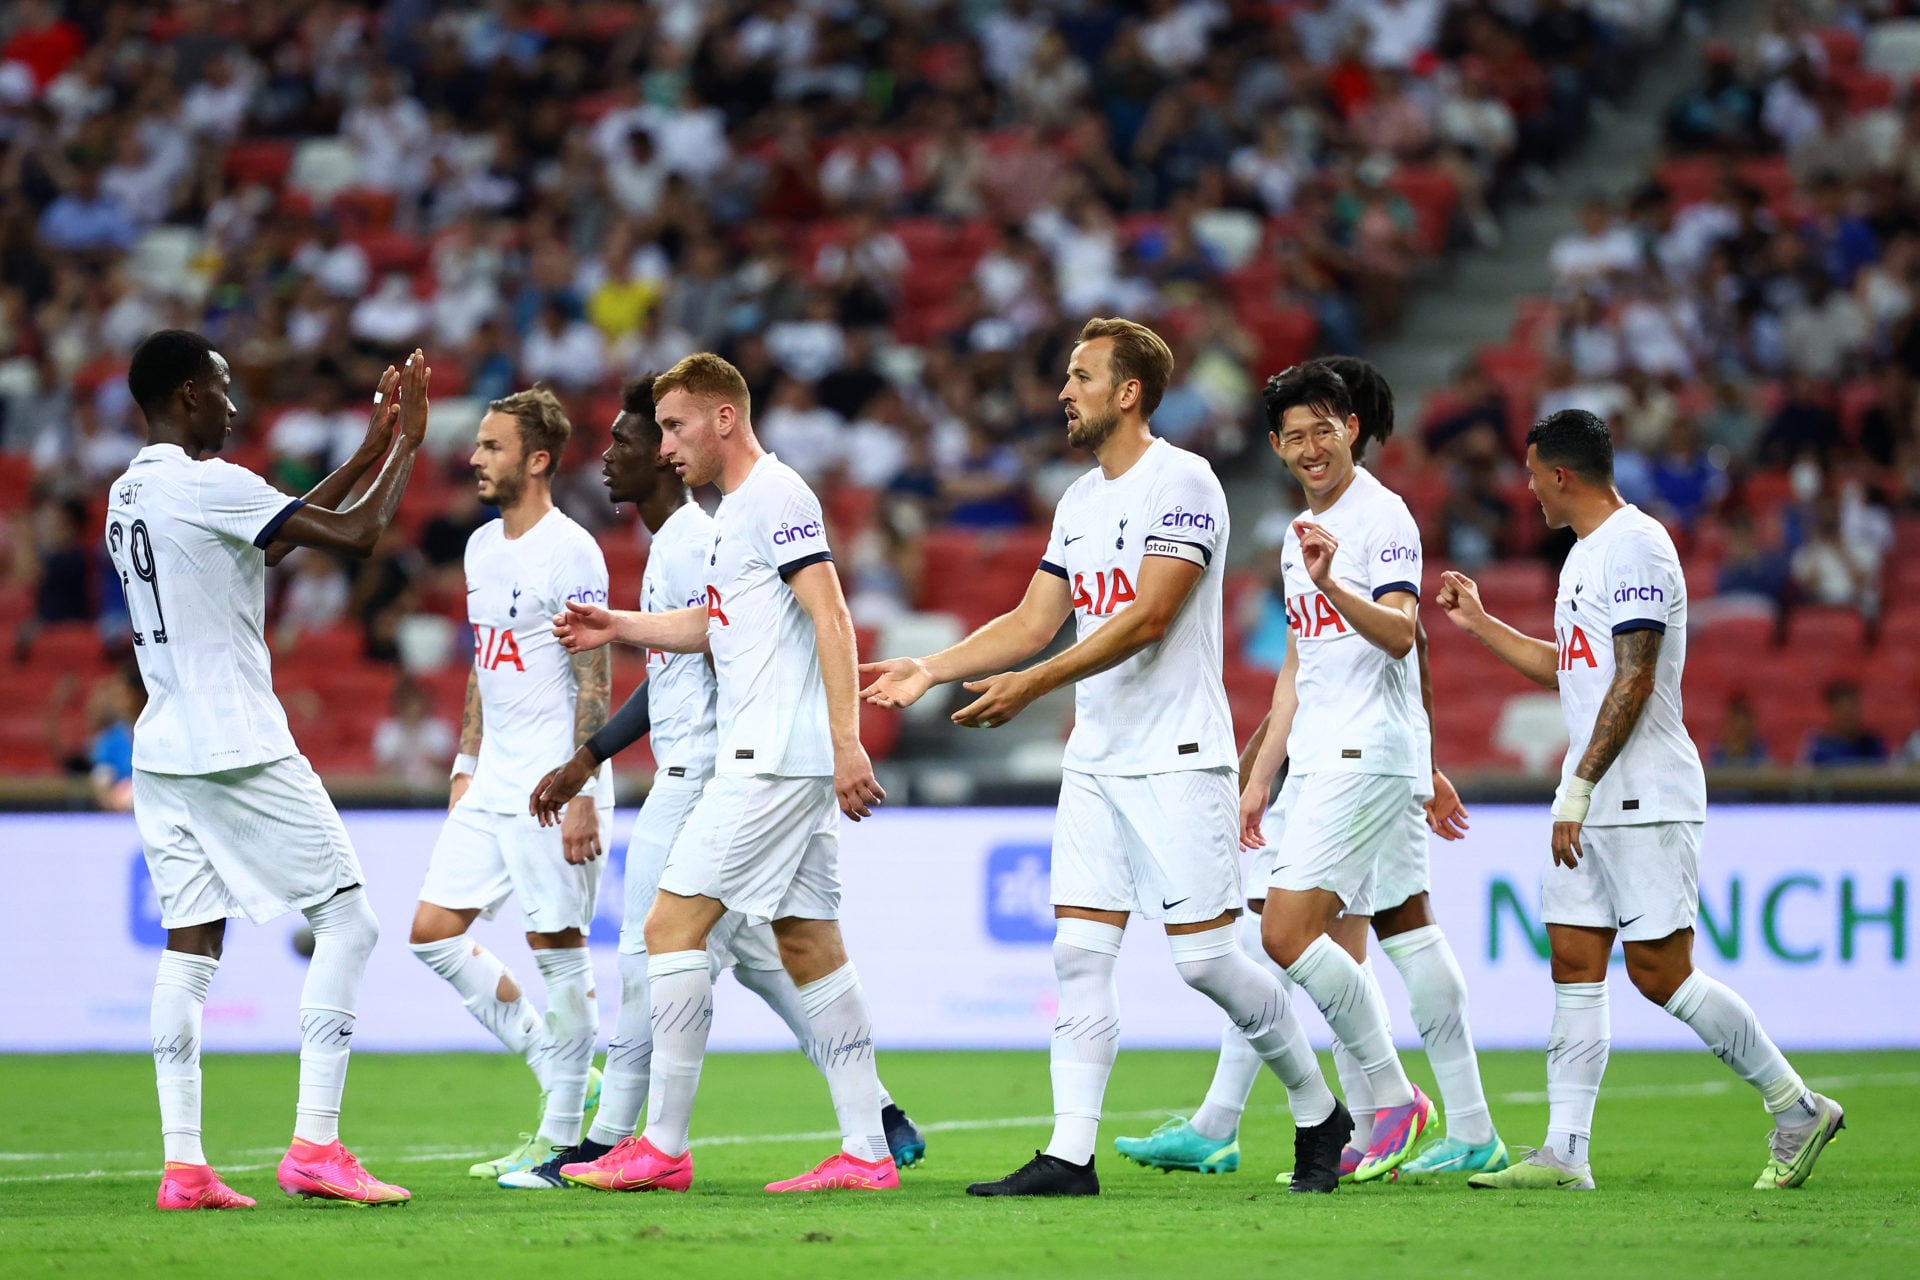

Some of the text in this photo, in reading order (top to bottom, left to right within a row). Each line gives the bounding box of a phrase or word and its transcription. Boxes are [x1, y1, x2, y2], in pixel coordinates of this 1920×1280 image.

[1162, 505, 1215, 532] cinch
[1146, 543, 1178, 554] ptain
[1072, 568, 1136, 614] AIA
[1614, 581, 1663, 603] cinch
[1287, 593, 1346, 637] AIA
[1560, 625, 1597, 670] IA
[1487, 875, 1908, 964] NNCH
